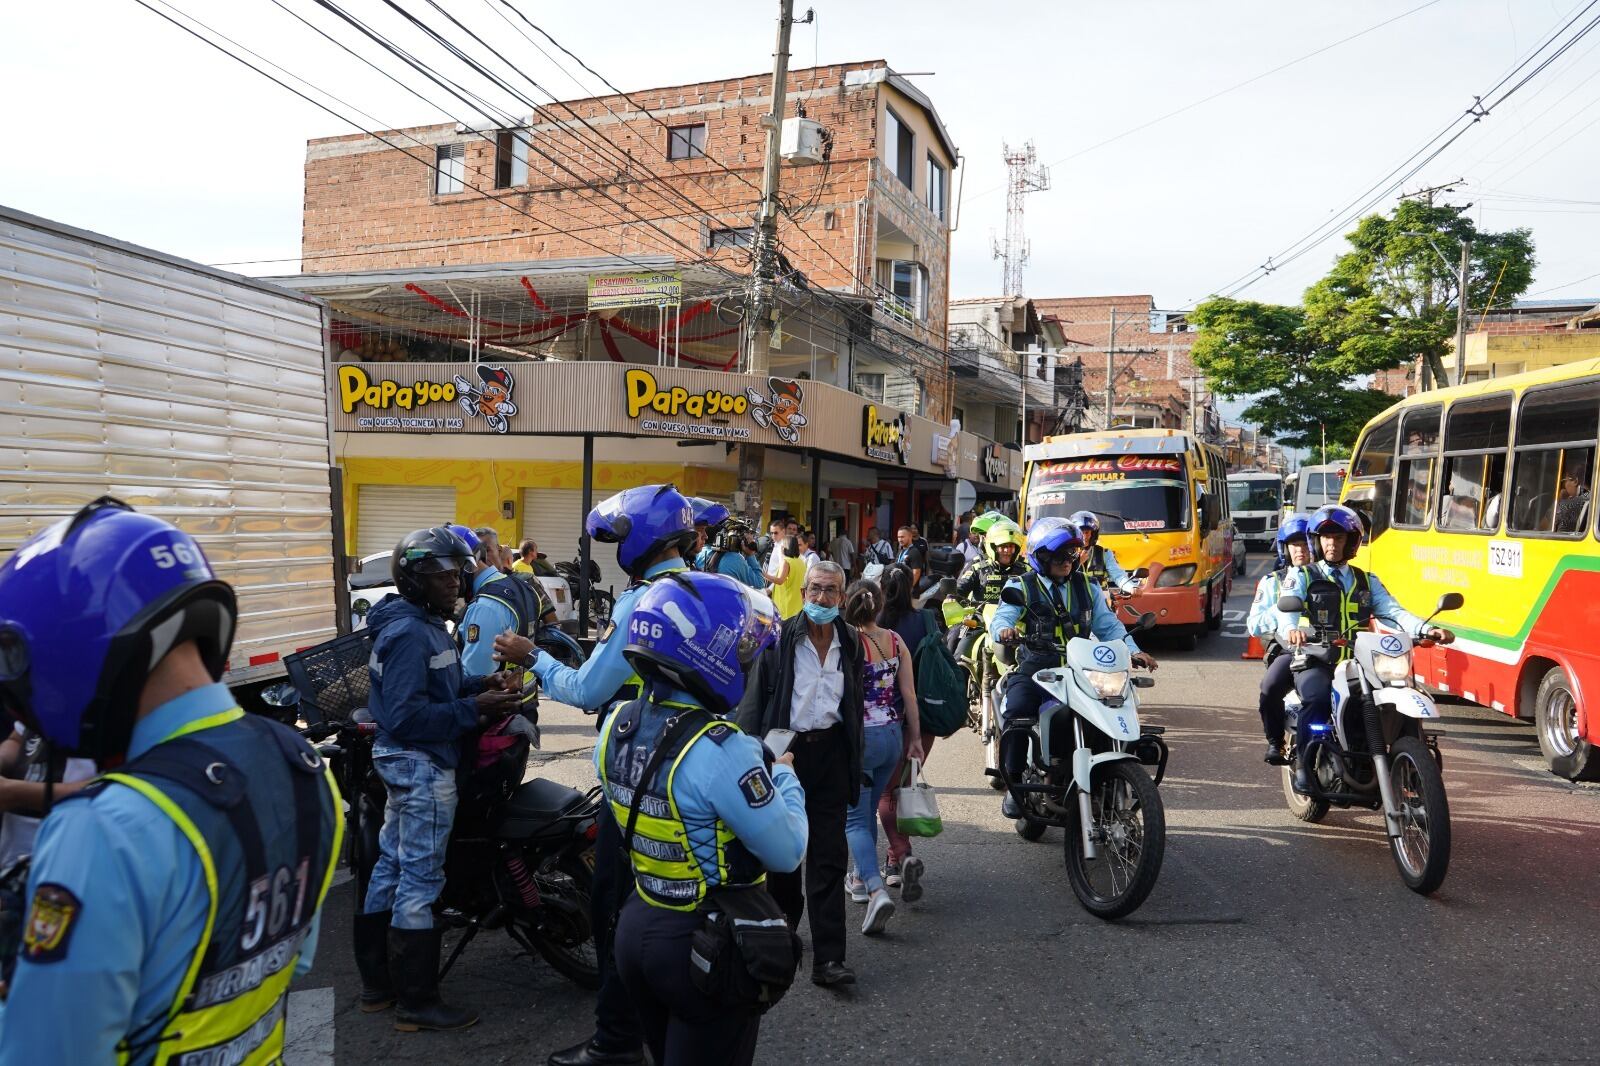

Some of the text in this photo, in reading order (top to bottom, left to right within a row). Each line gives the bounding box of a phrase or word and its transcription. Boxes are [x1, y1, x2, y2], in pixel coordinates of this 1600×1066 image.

[596, 277, 633, 286] DESAYUNOS
[359, 417, 464, 428] CON QUESO, TOCINETA Y MAS
[642, 420, 658, 431] CON
[661, 422, 687, 433] QUESO,
[689, 424, 723, 436] TOCINETA
[734, 429, 750, 438] MAS
[1034, 458, 1114, 477] Santa
[1117, 455, 1181, 472] Cruz
[1081, 473, 1115, 481] POPULAR
[1491, 547, 1505, 565] TSZ
[1507, 549, 1520, 567] 911
[631, 618, 663, 639] 466
[241, 855, 311, 950] 561
